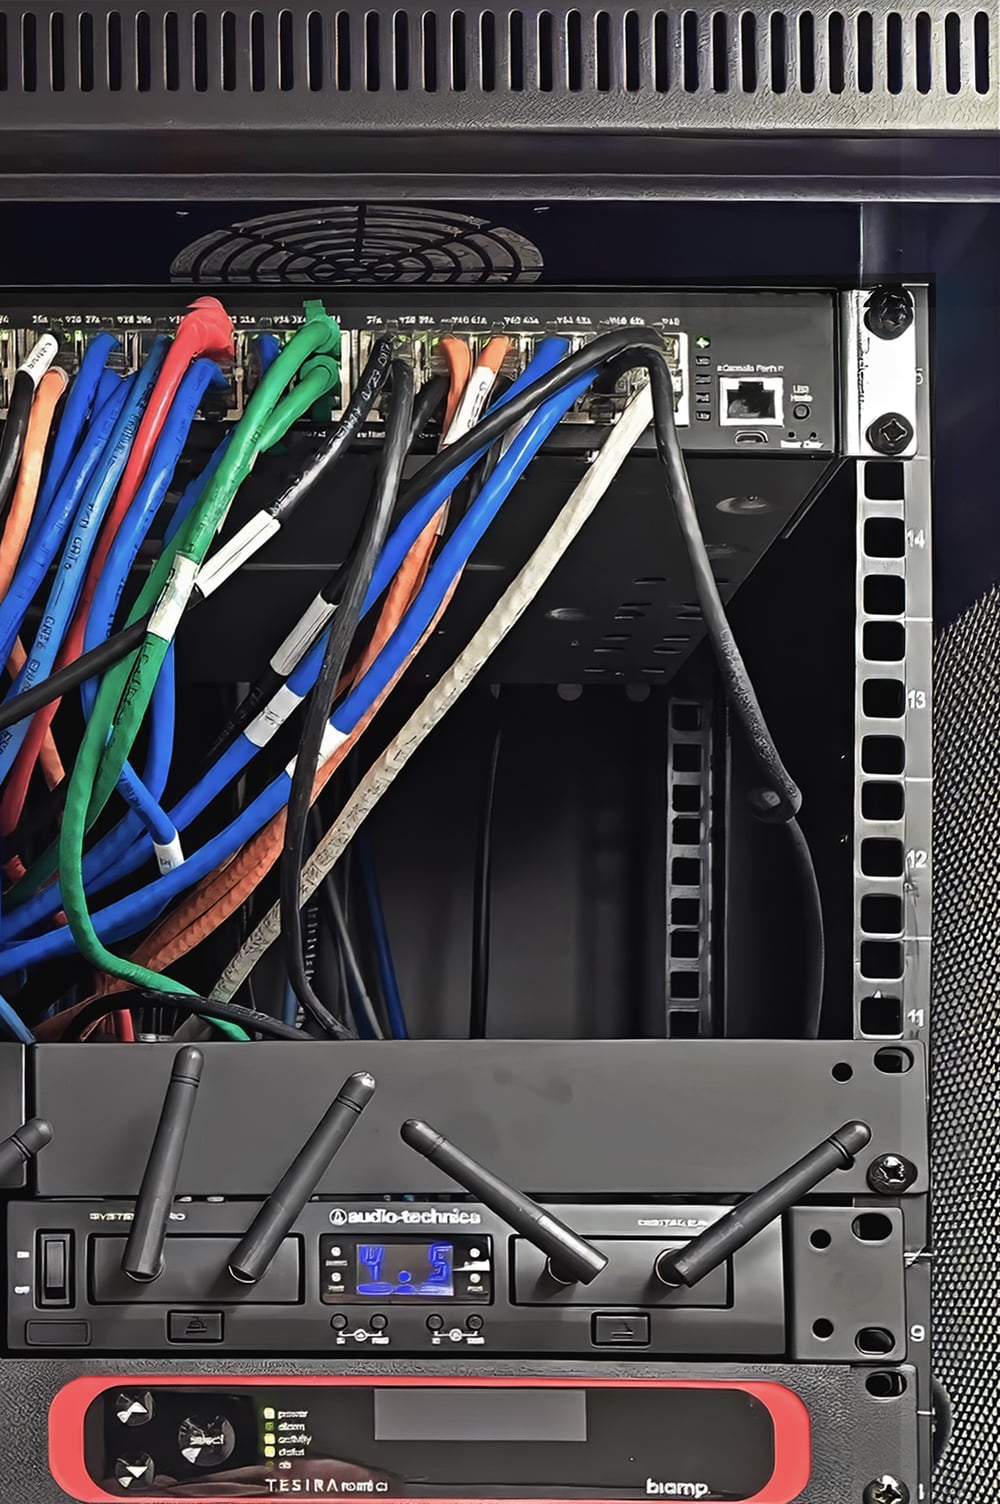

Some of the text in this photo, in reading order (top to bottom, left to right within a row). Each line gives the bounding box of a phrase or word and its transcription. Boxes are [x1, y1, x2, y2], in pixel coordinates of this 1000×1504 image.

[906, 529, 926, 548] 14
[906, 689, 927, 709] 13
[907, 850, 928, 869] 12
[907, 1010, 925, 1028] 11
[348, 1207, 481, 1224] audio-technica
[909, 1324, 927, 1342] 9
[265, 1478, 339, 1493] TESIRA
